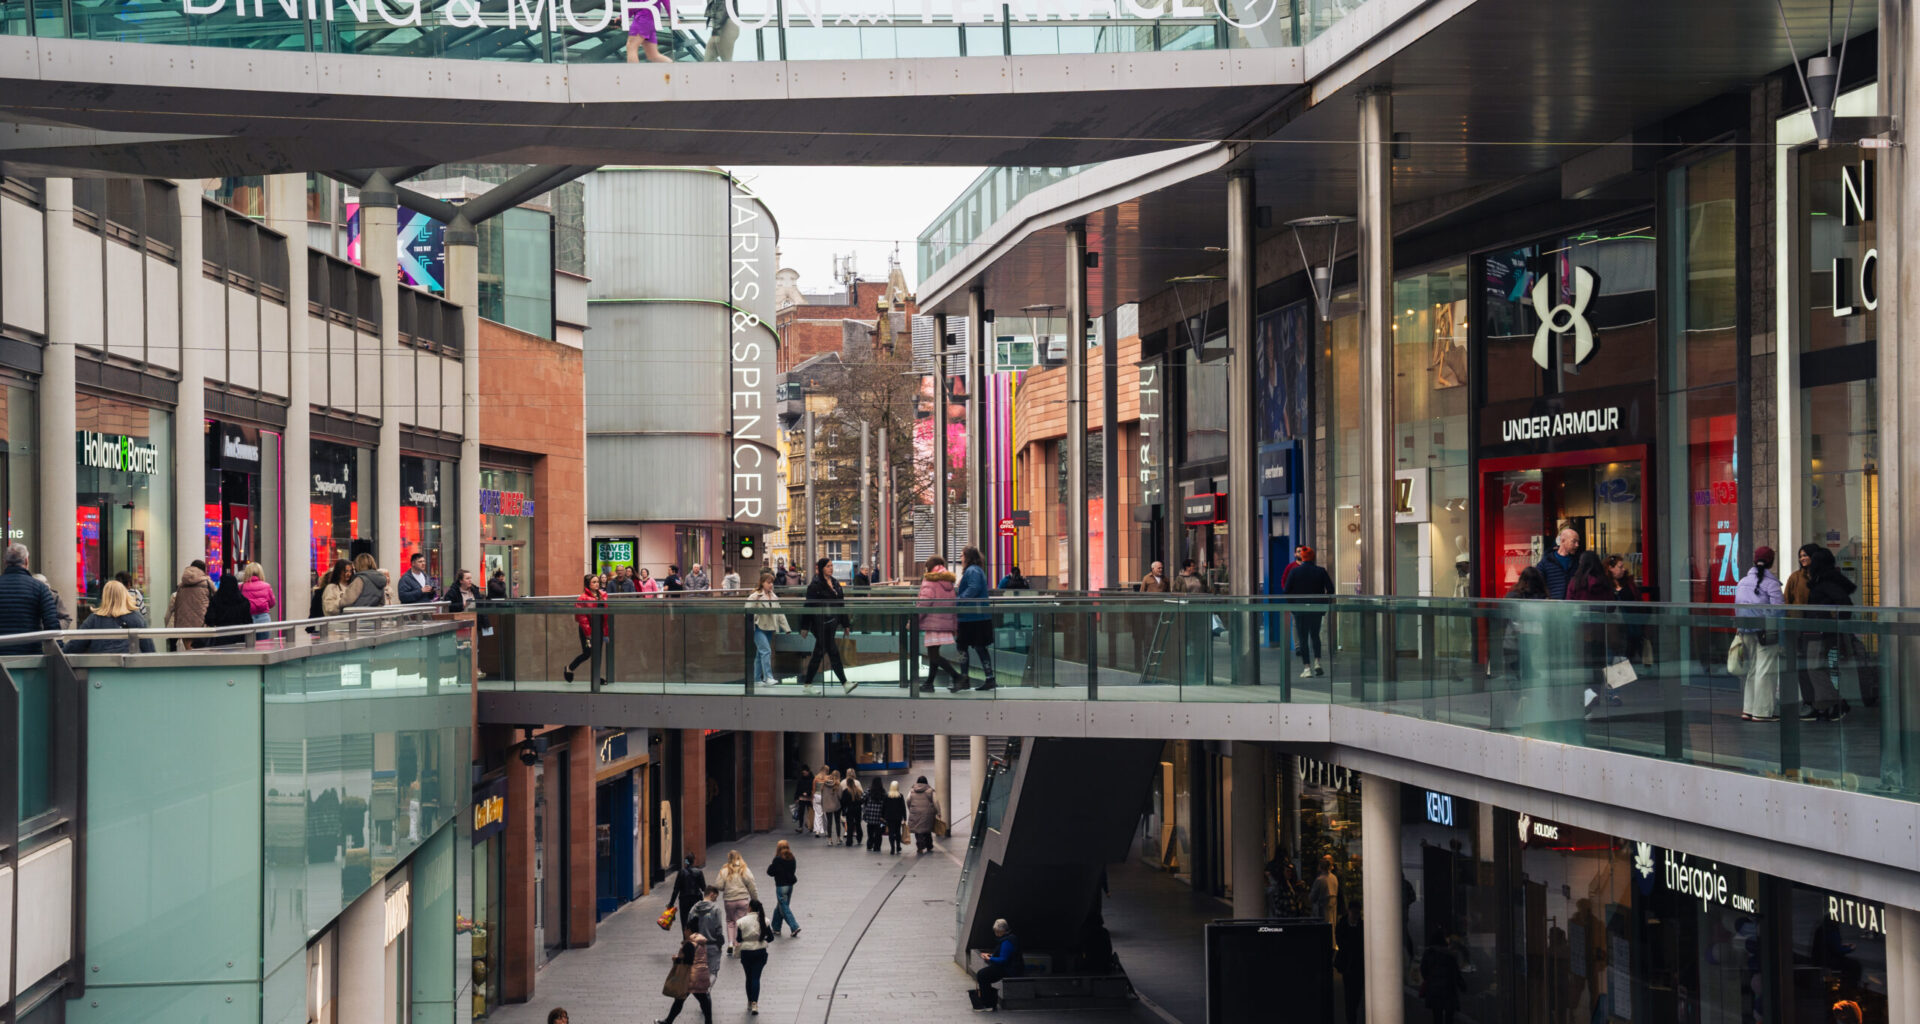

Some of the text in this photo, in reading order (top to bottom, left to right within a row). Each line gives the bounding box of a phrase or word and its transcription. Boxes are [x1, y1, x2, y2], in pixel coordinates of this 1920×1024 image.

[731, 173, 762, 520] MARKS & SPENCER
[1503, 406, 1619, 442] UNDER ARMOUR
[84, 430, 122, 470] Holland
[128, 437, 158, 475] Barrett
[599, 543, 631, 552] SAVER
[599, 551, 631, 561] SUBS
[1426, 791, 1453, 827] KENJI
[1533, 822, 1558, 840] HOLIDAYS
[1665, 849, 1755, 913] thérapie CLINIC
